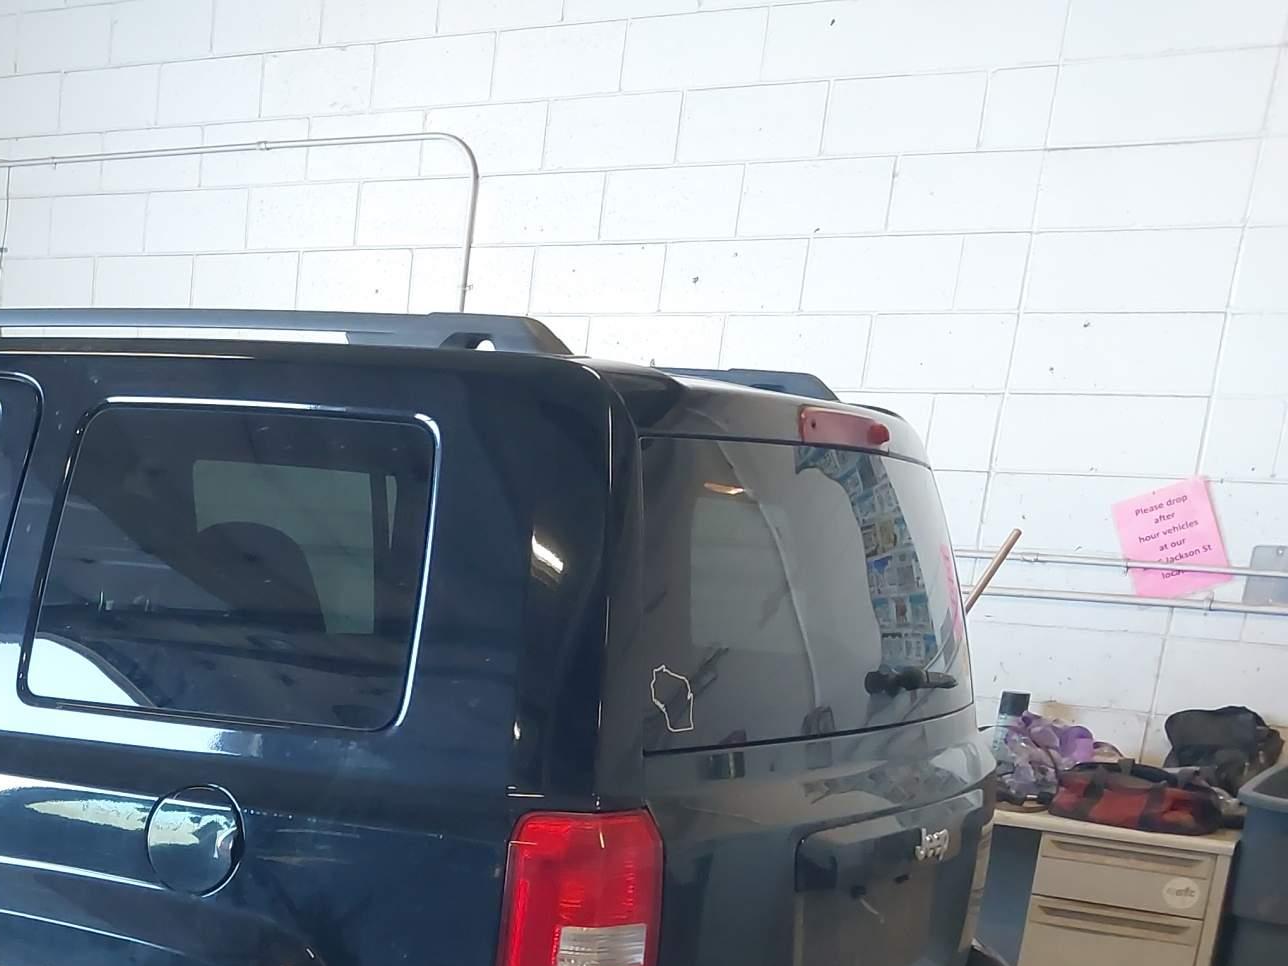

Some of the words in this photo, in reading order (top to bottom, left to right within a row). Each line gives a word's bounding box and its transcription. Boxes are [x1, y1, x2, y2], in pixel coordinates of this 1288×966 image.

[1134, 502, 1164, 516] Please
[1166, 495, 1188, 506] drop
[1154, 512, 1175, 524] after
[1138, 532, 1160, 543] hour
[1162, 520, 1199, 535] vehicles
[1170, 538, 1186, 548] our
[1165, 548, 1201, 564] Jackson
[1202, 544, 1213, 553] St
[914, 827, 949, 861] Jeep
